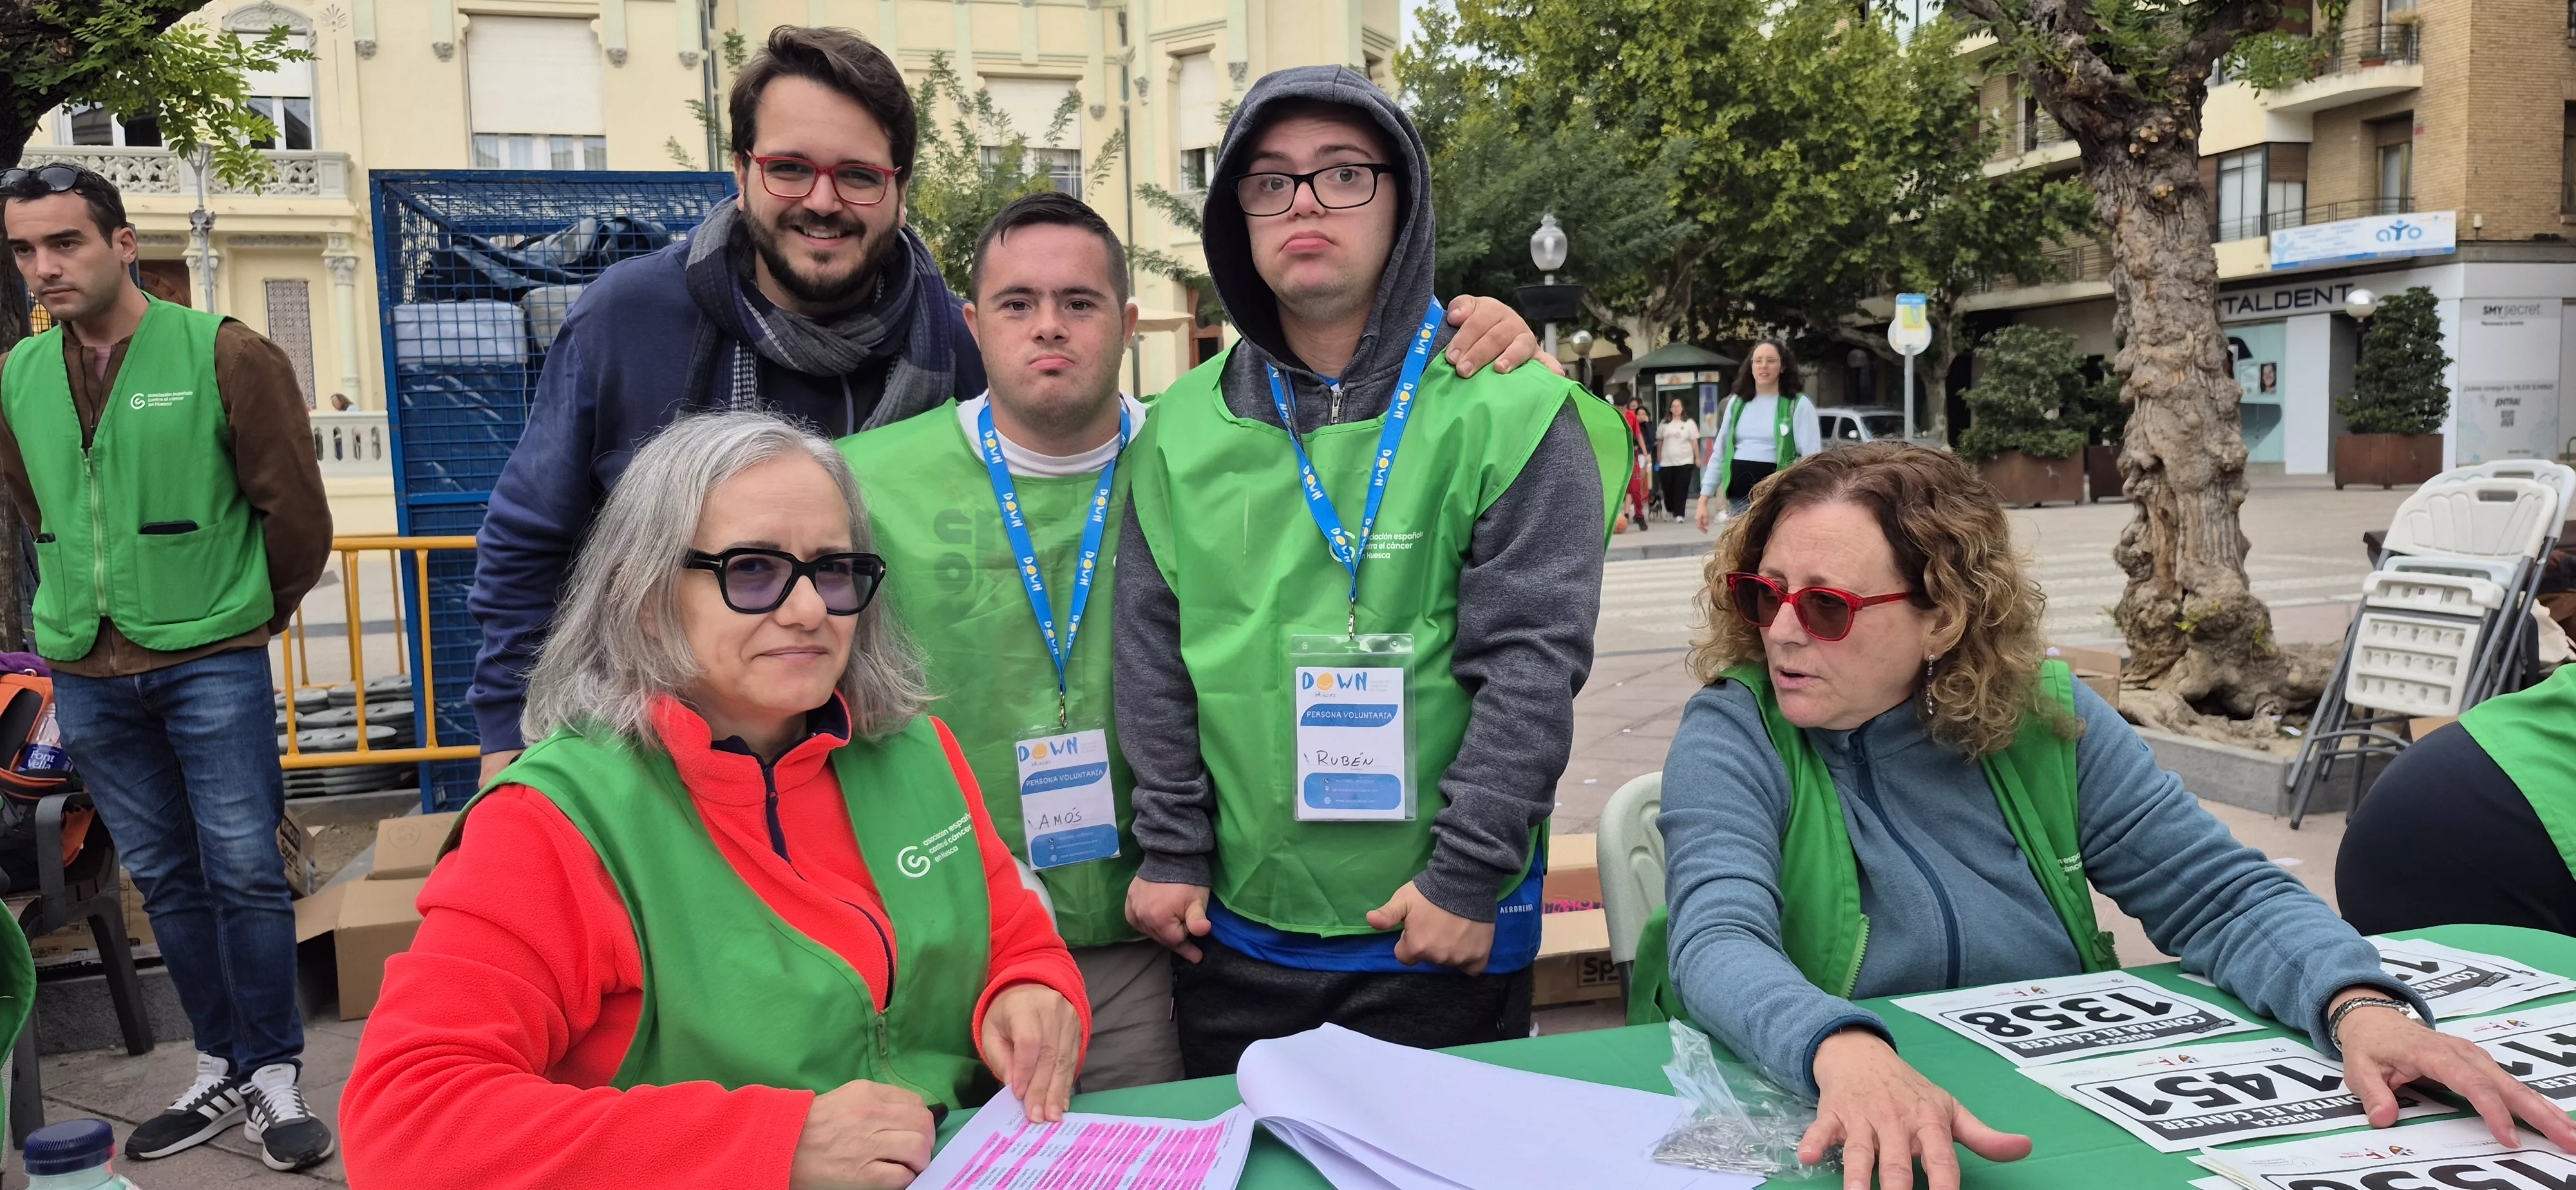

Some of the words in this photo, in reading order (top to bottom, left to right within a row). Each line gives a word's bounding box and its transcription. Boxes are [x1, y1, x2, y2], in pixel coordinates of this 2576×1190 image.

[1414, 322, 1435, 355] DOWN
[1393, 382, 1414, 419] DOWN
[984, 430, 1003, 464] DOWN
[1373, 449, 1392, 487] DOWN
[1303, 465, 1323, 501] DOWN
[1003, 492, 1023, 528] DOWN
[1092, 488, 1108, 523] DOWN
[1330, 527, 1351, 563] DOWN
[1368, 533, 1392, 541] ciación
[1023, 556, 1043, 591] DOWN
[1079, 551, 1095, 587] DOWN
[1044, 621, 1059, 655] DOWN
[1302, 671, 1367, 691] DOWN
[1307, 710, 1341, 719] PERSONA
[1343, 711, 1393, 720] VOLUNTARIA
[30, 750, 56, 763] Font
[1018, 736, 1078, 762] DOWN
[28, 759, 52, 770] Vella
[1026, 775, 1059, 787] PERSONA
[1059, 769, 1104, 782] VOLUNTARIA
[949, 813, 971, 831] españ
[1039, 806, 1083, 830] AMÓS
[947, 824, 972, 843] cáncer
[2063, 852, 2081, 864] espa
[1959, 992, 2172, 1037] 1358
[2125, 1015, 2206, 1033] CONTRA
[2012, 1030, 2097, 1050] CÁNCER
[2094, 1032, 2157, 1046] HUESCA
[2096, 1028, 2125, 1041] EL
[2096, 1064, 2343, 1116] 1451
[2528, 1075, 2576, 1090] CER
[2253, 1104, 2284, 1117] EL
[2282, 1094, 2362, 1115] ONTRA
[2154, 1110, 2254, 1131] CÁNCER
[2250, 1111, 2324, 1127] HUESCA
